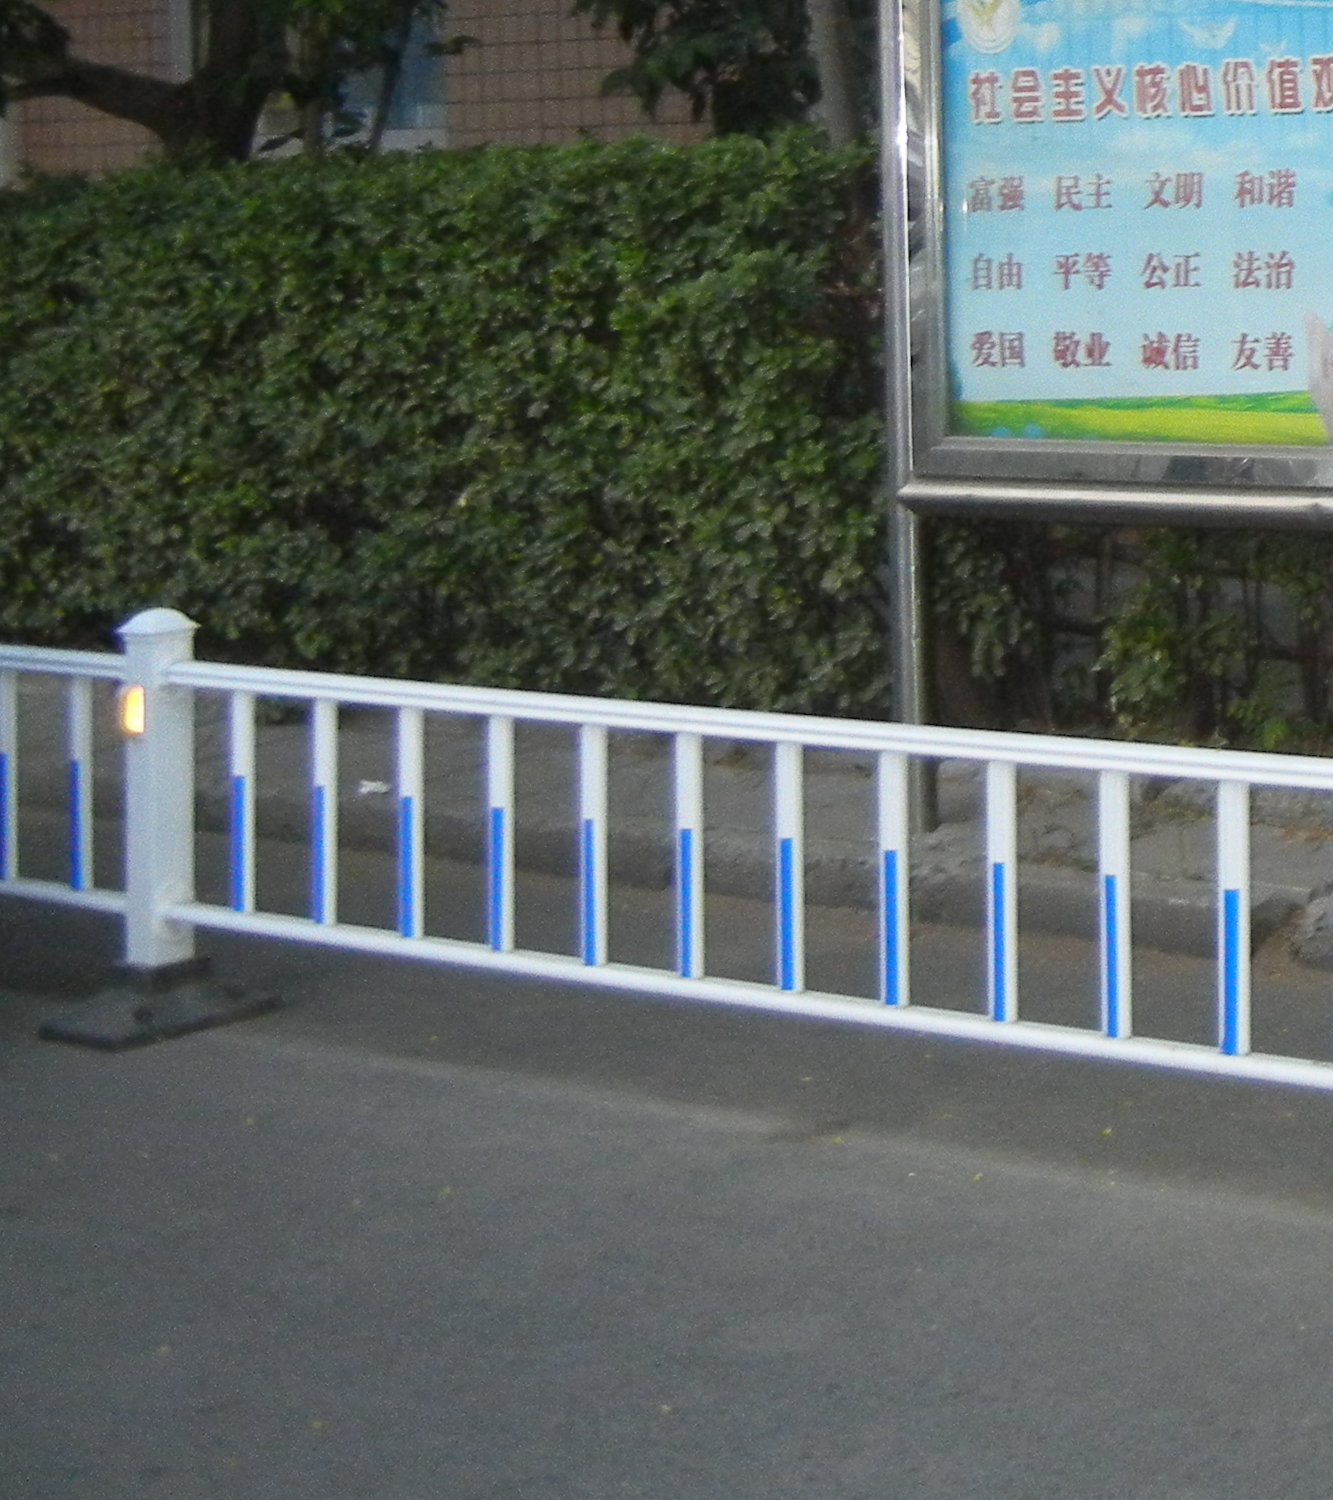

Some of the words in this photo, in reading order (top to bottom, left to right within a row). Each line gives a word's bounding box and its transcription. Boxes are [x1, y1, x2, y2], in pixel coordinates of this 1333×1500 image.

[968, 175, 1025, 213] 富强
[1053, 173, 1113, 211] 民主
[1143, 171, 1204, 210] 文明
[1233, 168, 1296, 209] 和谐
[971, 252, 1023, 291] 自由
[1053, 252, 1113, 291] 平等
[1141, 252, 1201, 290] 公正
[1232, 250, 1296, 290] 法治
[970, 331, 1026, 368] 爱国
[1053, 331, 1113, 368] 敬业
[1141, 332, 1201, 371] 诚信
[1232, 332, 1295, 371] 友善
